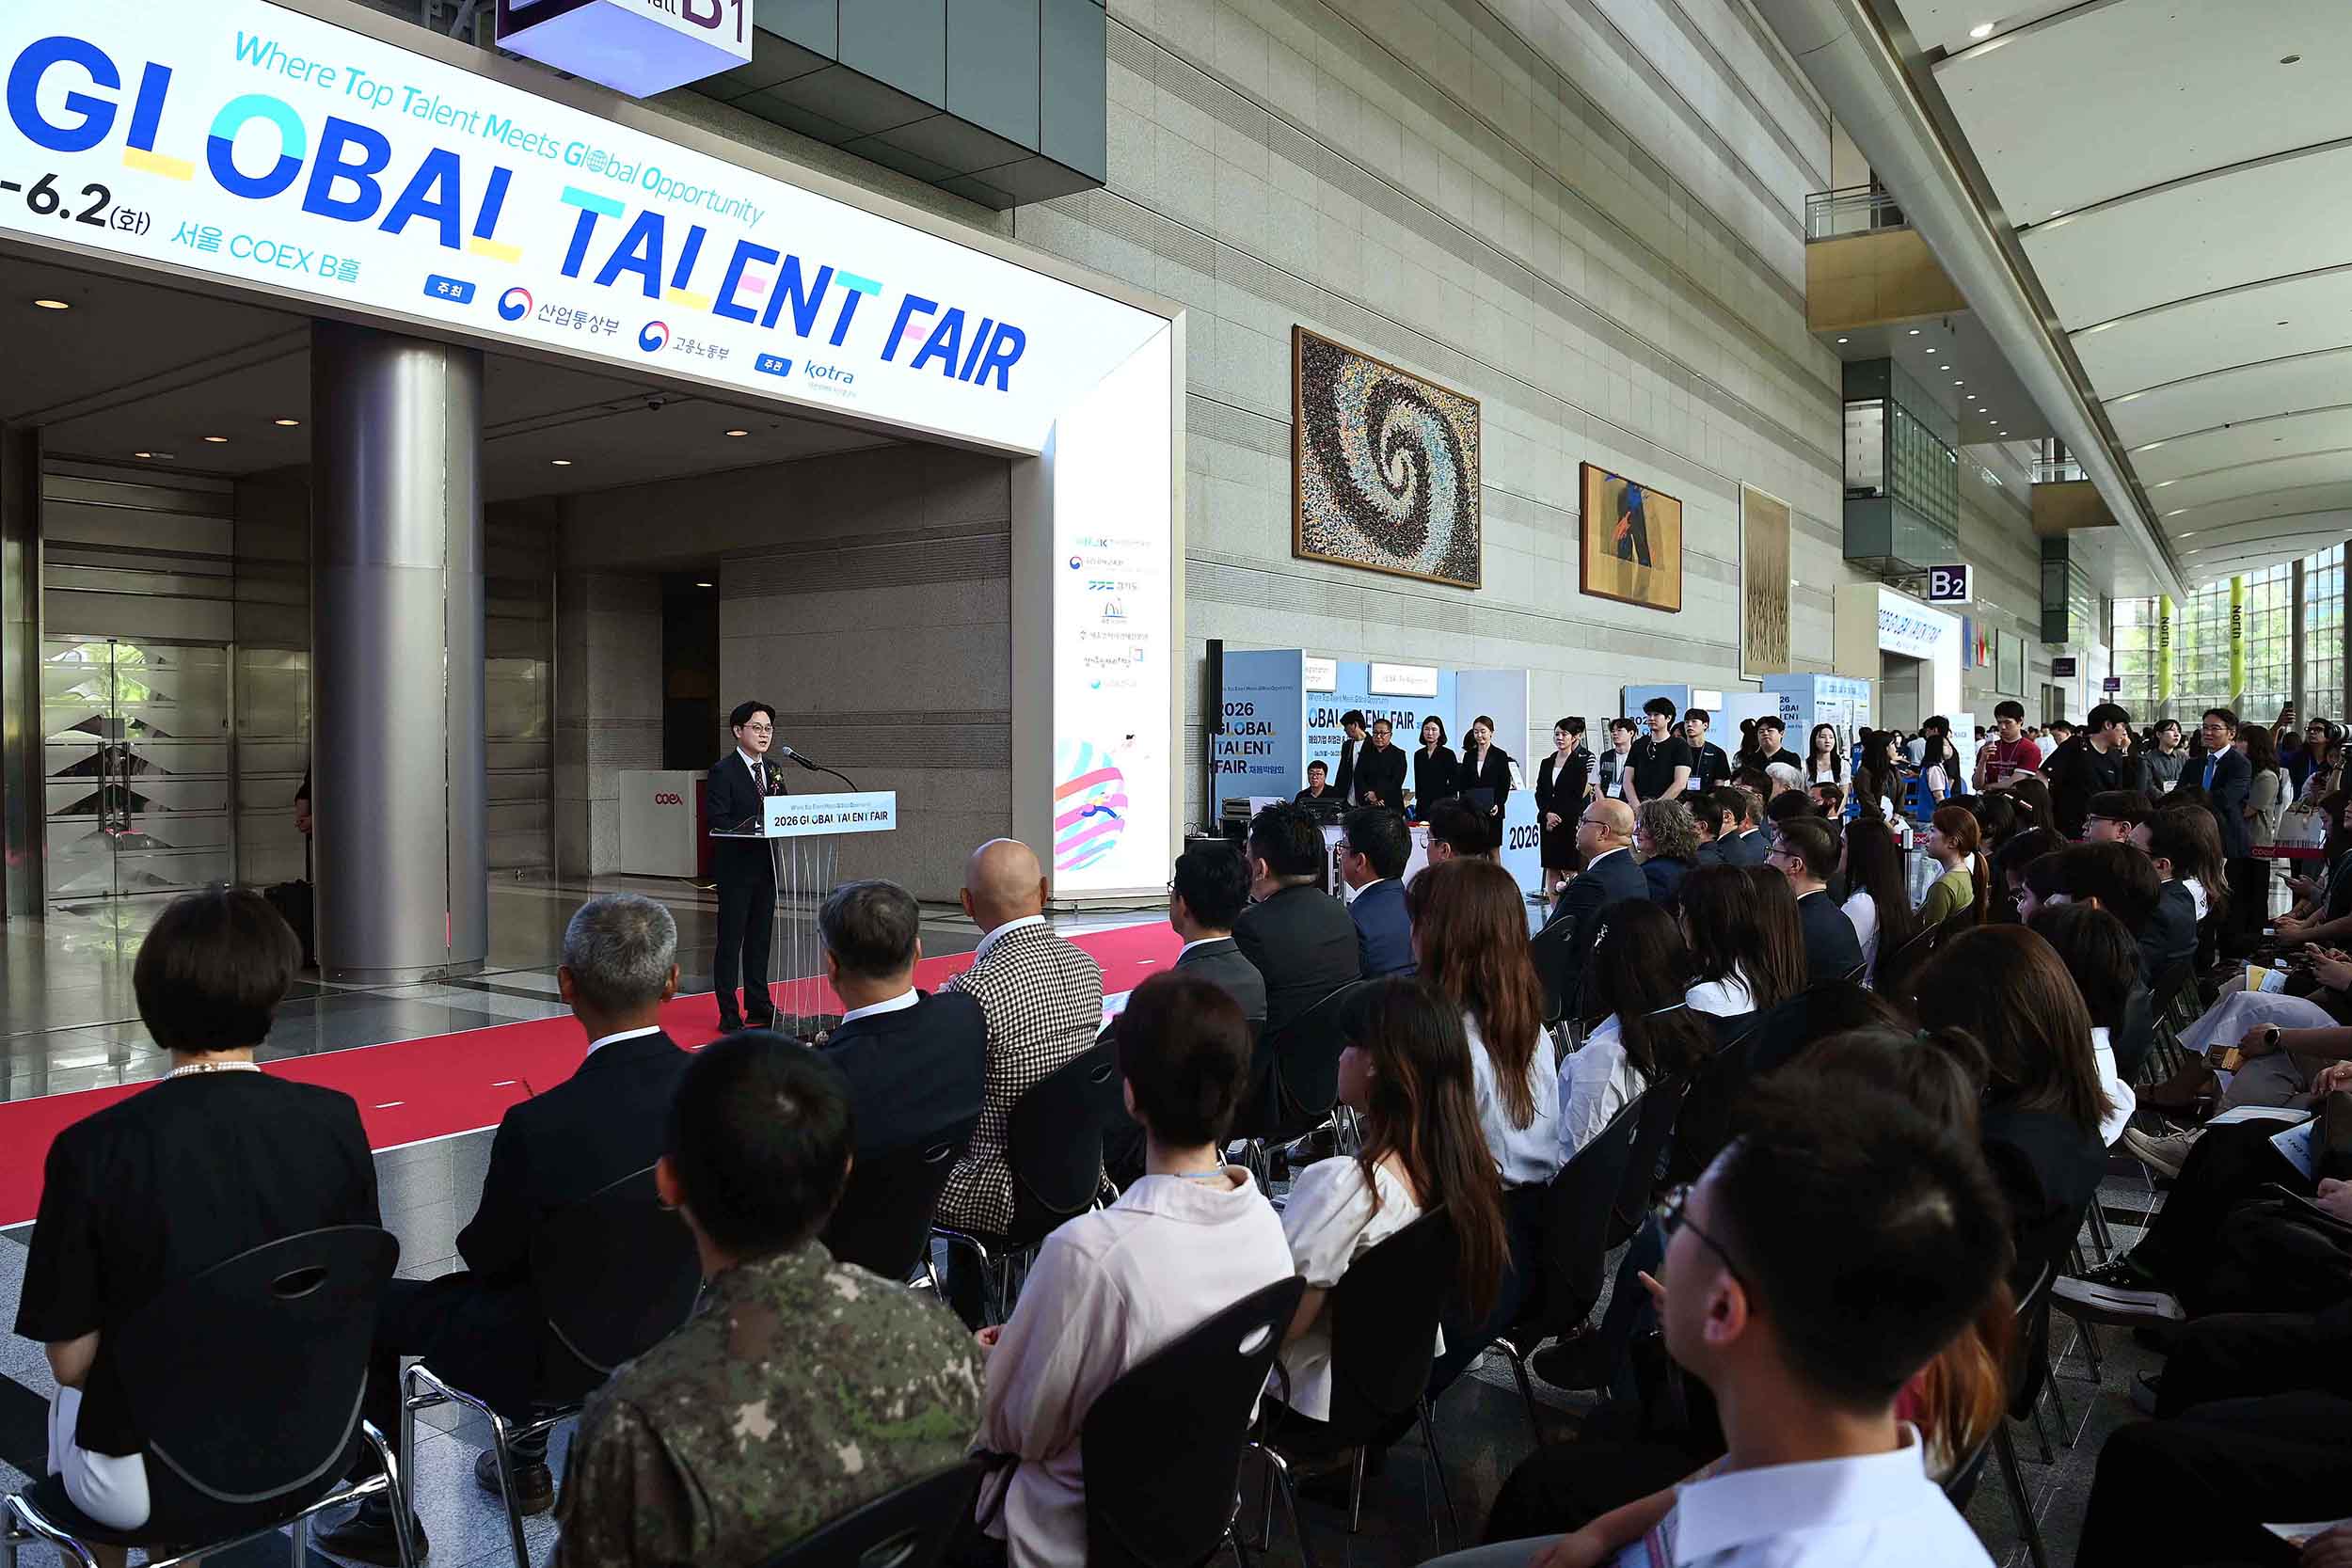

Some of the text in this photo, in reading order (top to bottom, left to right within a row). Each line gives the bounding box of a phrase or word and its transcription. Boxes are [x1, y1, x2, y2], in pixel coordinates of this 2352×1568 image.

[647, 0, 676, 15] all
[235, 31, 766, 228] Where Top Talent Meets Global Opportunity
[6, 35, 1027, 393] GLOBAL TALENT FAIR
[171, 220, 224, 253] 서울
[230, 234, 315, 273] COEX
[319, 254, 362, 283] B홀
[437, 281, 464, 298] 주최
[538, 304, 620, 337] 산업통상부
[672, 336, 730, 361] 고용노동부
[763, 358, 784, 372] 주관
[804, 359, 854, 384] kotra
[1931, 571, 1964, 595] B2
[2233, 605, 2242, 640] North
[1307, 707, 1343, 730] OBAL
[1391, 710, 1415, 730] FAIR
[1216, 740, 1275, 755] TALENT
[1216, 760, 1248, 774] FAIR
[774, 811, 888, 827] 2026 GLOBAL TALENT FAIR
[1509, 824, 1540, 850] 2026
